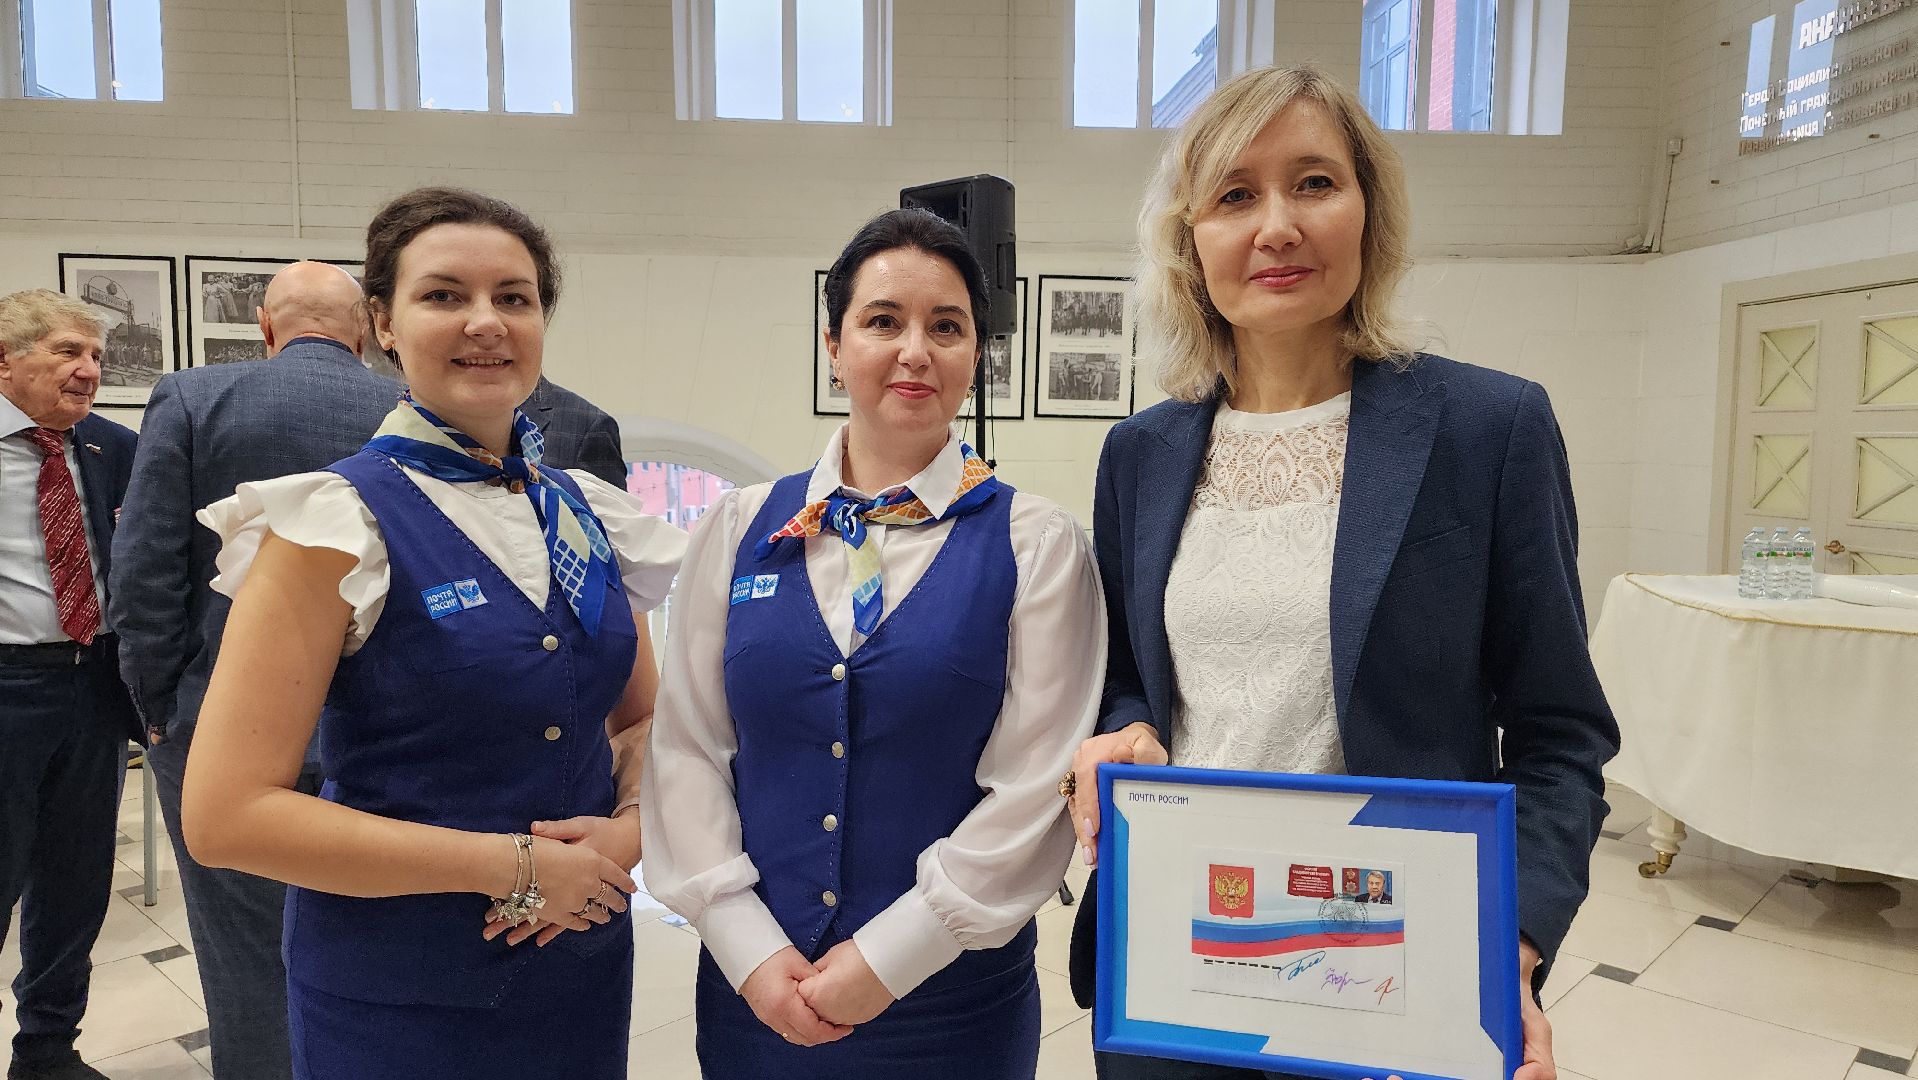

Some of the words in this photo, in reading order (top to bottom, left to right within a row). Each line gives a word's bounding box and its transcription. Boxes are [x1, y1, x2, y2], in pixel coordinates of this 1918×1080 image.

[427, 590, 455, 604] ПОЧТА
[431, 598, 458, 612] РОССИИ
[1129, 792, 1156, 803] ПОЧТА
[1158, 794, 1189, 806] РОССИИ
